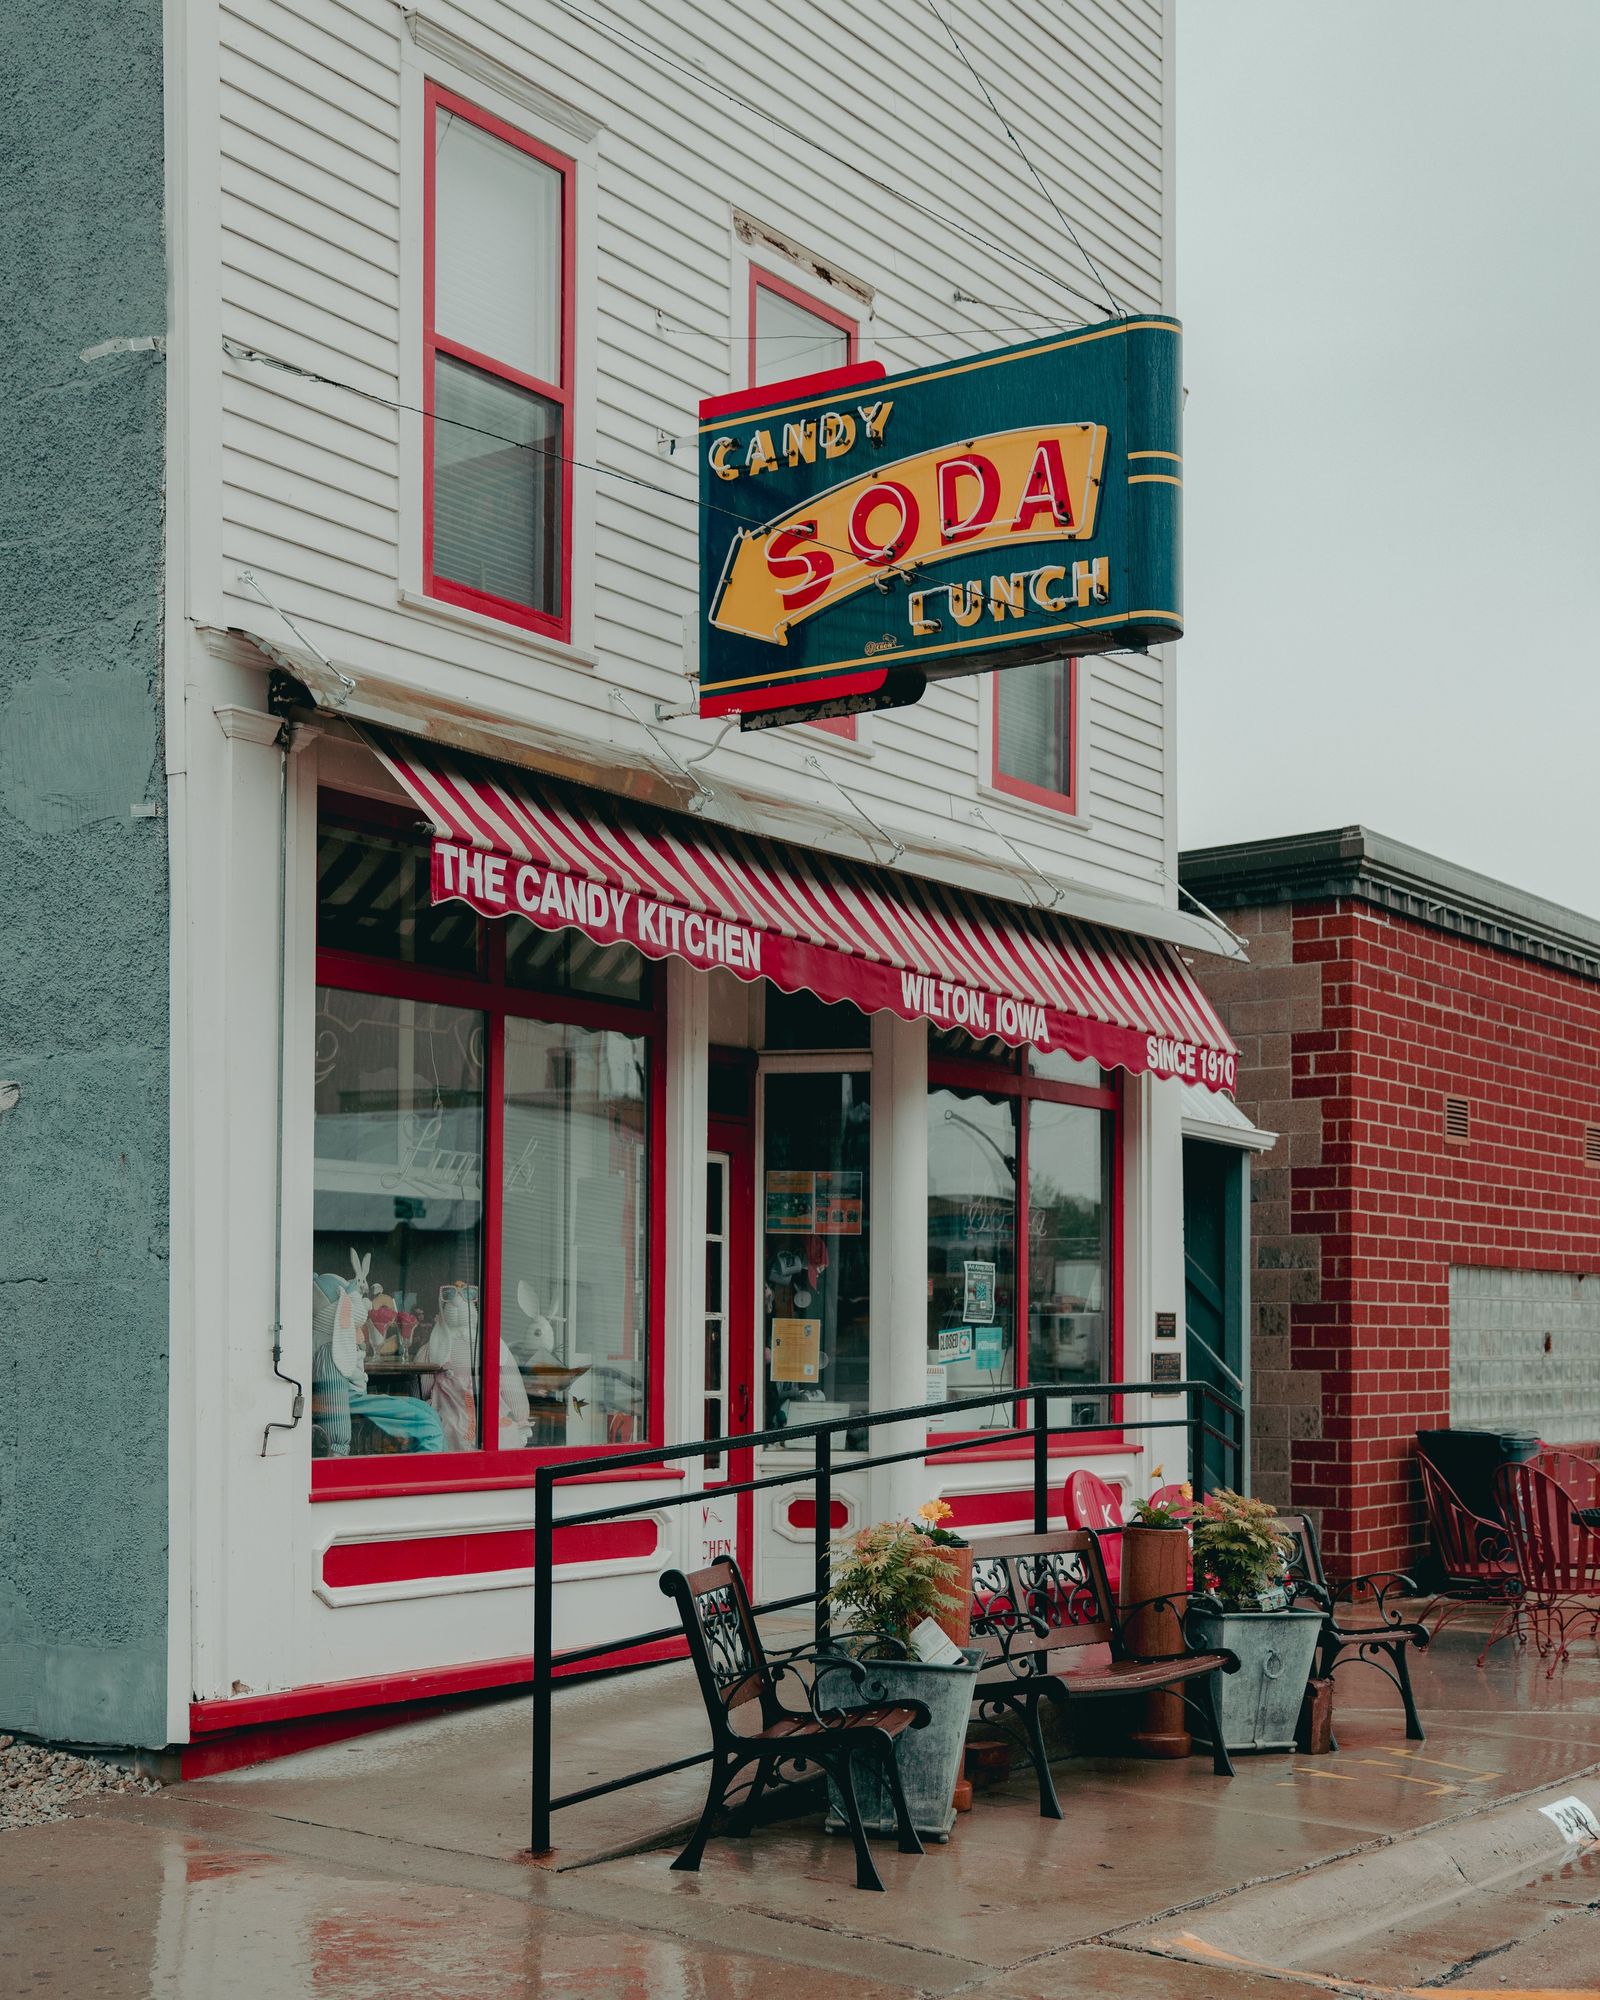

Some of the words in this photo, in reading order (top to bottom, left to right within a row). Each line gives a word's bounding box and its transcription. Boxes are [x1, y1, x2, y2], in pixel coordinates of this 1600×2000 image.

[708, 401, 894, 480] CANDY
[764, 440, 1075, 611] SODA
[908, 556, 1109, 636] LUNCH
[434, 843, 508, 904] THE
[515, 865, 631, 934] CANDY
[637, 900, 761, 971] KITCHEN
[900, 971, 990, 1030] WILTON,
[995, 998, 1050, 1043] IOWA
[1146, 1035, 1196, 1077] SINCE
[1200, 1049, 1235, 1086] 1910
[940, 1332, 959, 1351] CLOSED
[1101, 1503, 1118, 1528] K
